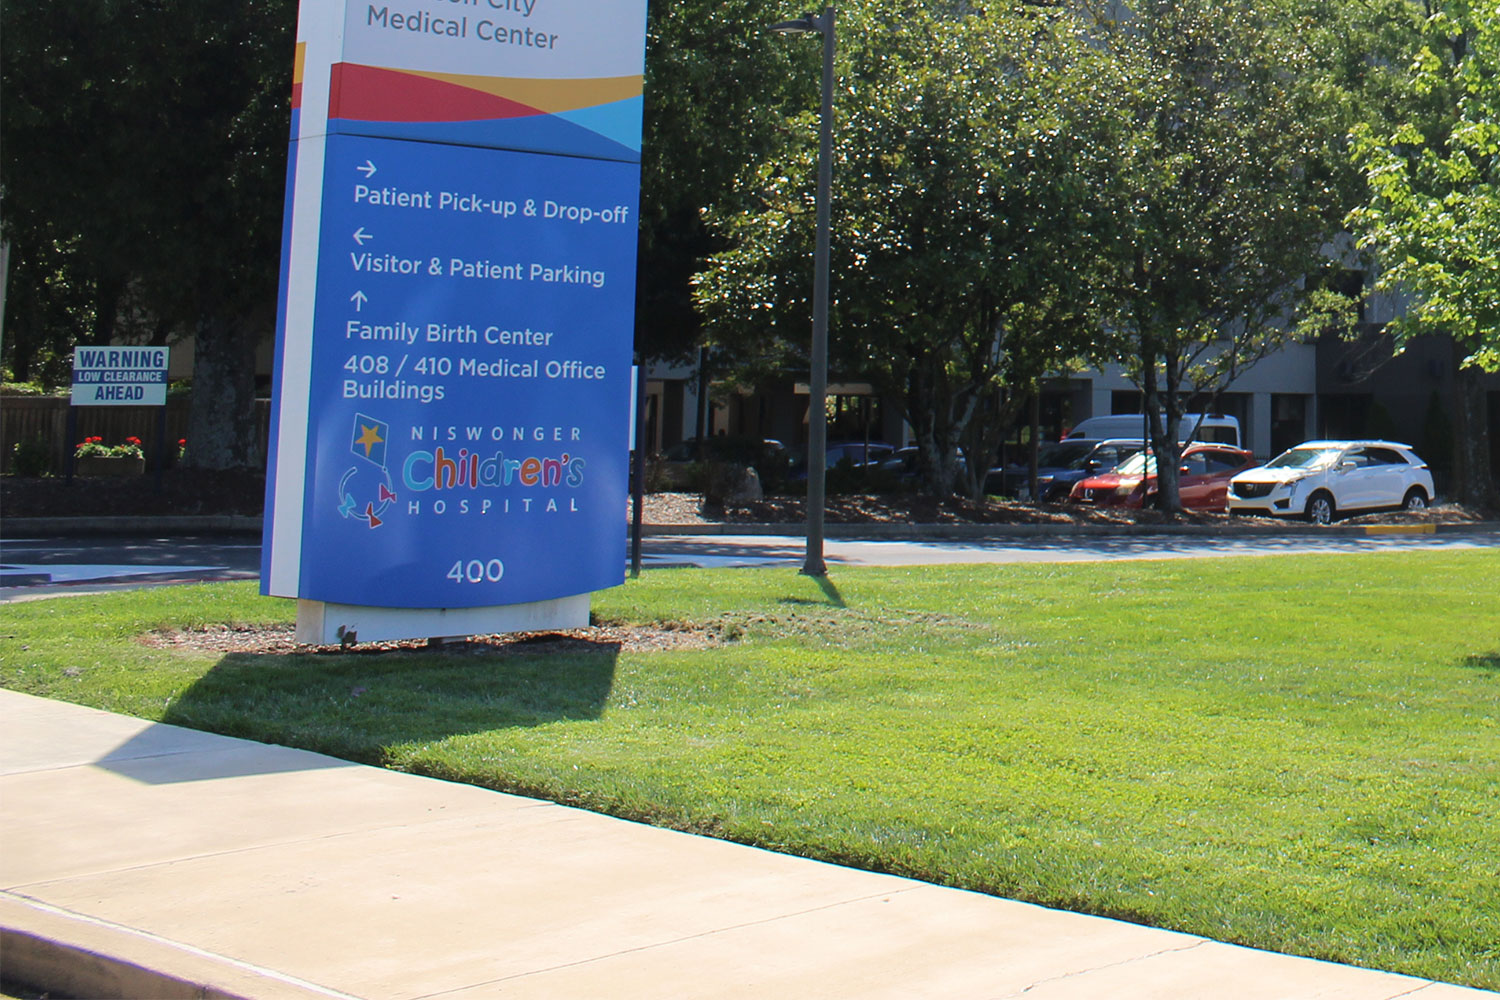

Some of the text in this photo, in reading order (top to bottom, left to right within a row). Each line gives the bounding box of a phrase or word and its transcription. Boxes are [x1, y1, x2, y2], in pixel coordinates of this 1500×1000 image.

[367, 5, 559, 50] Medical Center
[354, 185, 629, 224] Patient Pick-up & Drop-off
[350, 253, 605, 288] Visitor & Patient Parking
[346, 321, 553, 346] Family Birth Center
[80, 351, 164, 368] WARNING
[344, 355, 389, 375] 408
[414, 357, 452, 376] 410
[459, 358, 538, 378] Medical
[546, 360, 606, 380] Office
[78, 371, 162, 382] LOW CLEARANCE
[95, 386, 144, 400] AHEAD
[343, 380, 445, 403] Buildings
[411, 426, 581, 441] NISWONGER
[402, 446, 586, 491] Children's
[408, 498, 578, 514] HOSPITAL
[447, 558, 504, 584] 400
